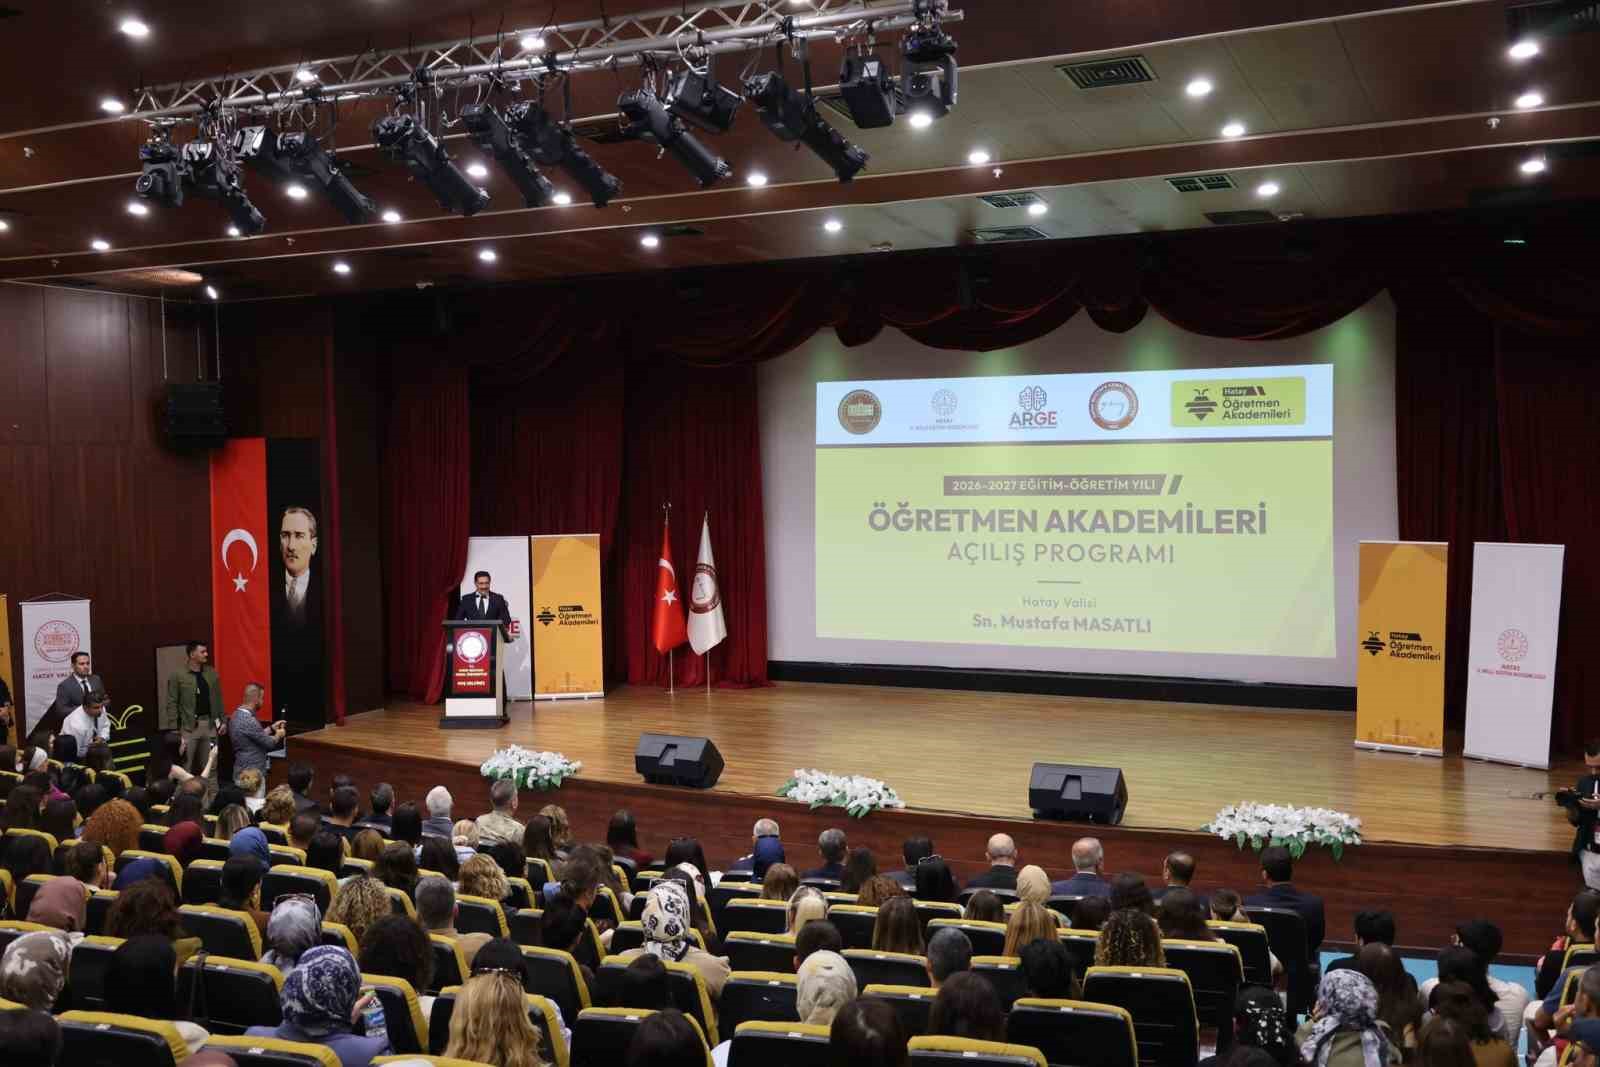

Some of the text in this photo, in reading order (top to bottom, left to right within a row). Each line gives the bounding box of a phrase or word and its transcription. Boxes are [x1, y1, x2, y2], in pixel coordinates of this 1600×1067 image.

[1222, 397, 1280, 411] Öğretmen
[1009, 411, 1057, 426] ARGE
[1222, 409, 1291, 420] Akademileri
[952, 478, 1156, 490] 2026-2027 EĞİTİM-ÖĞRETİM YILI
[868, 501, 1267, 535] ÖĞRETMEN AKADEMİLERİ
[947, 542, 1174, 566] AÇILIŞ PROGRAMI
[1022, 597, 1097, 609] Hatay Valisi
[973, 614, 1152, 633] Sn. Mustafa MASATLI
[1390, 650, 1441, 661] Akademileri
